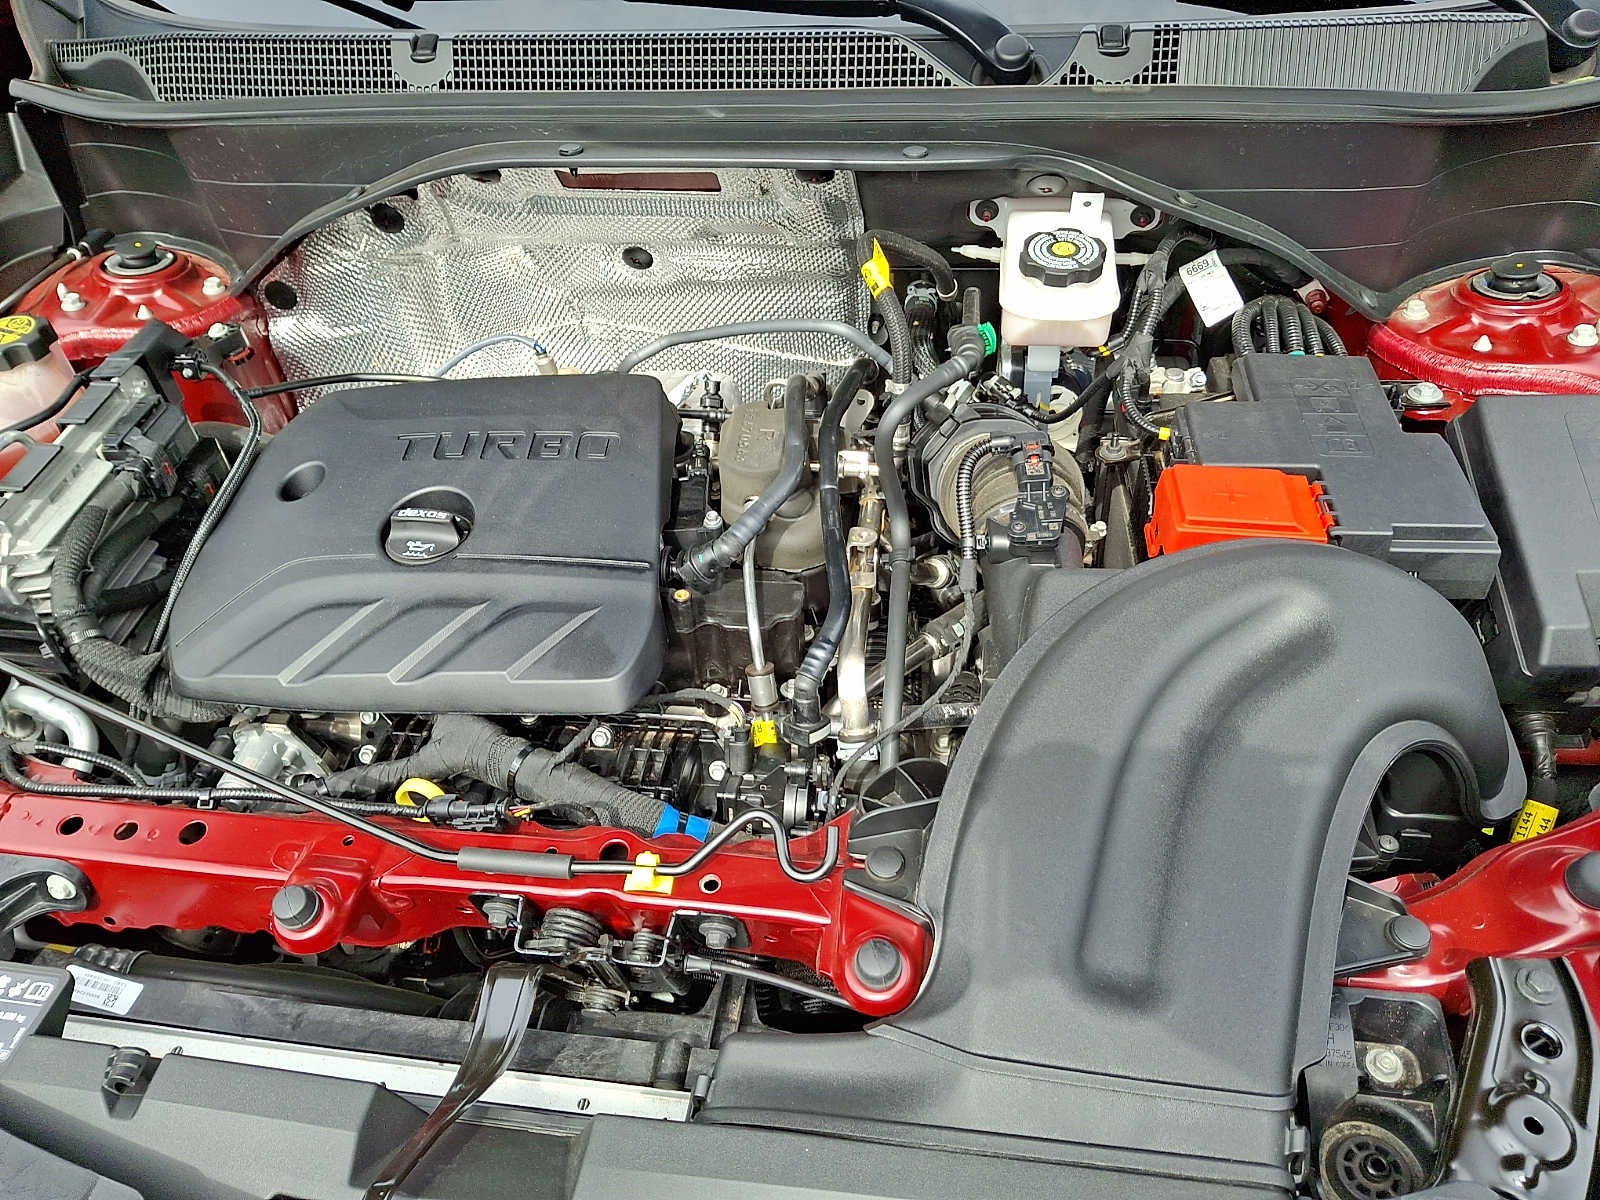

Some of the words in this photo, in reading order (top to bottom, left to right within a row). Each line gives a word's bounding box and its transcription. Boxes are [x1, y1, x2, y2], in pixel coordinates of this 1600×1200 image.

[398, 430, 622, 460] TURBO
[398, 507, 448, 519] dexos
[1516, 812, 1533, 837] 1144
